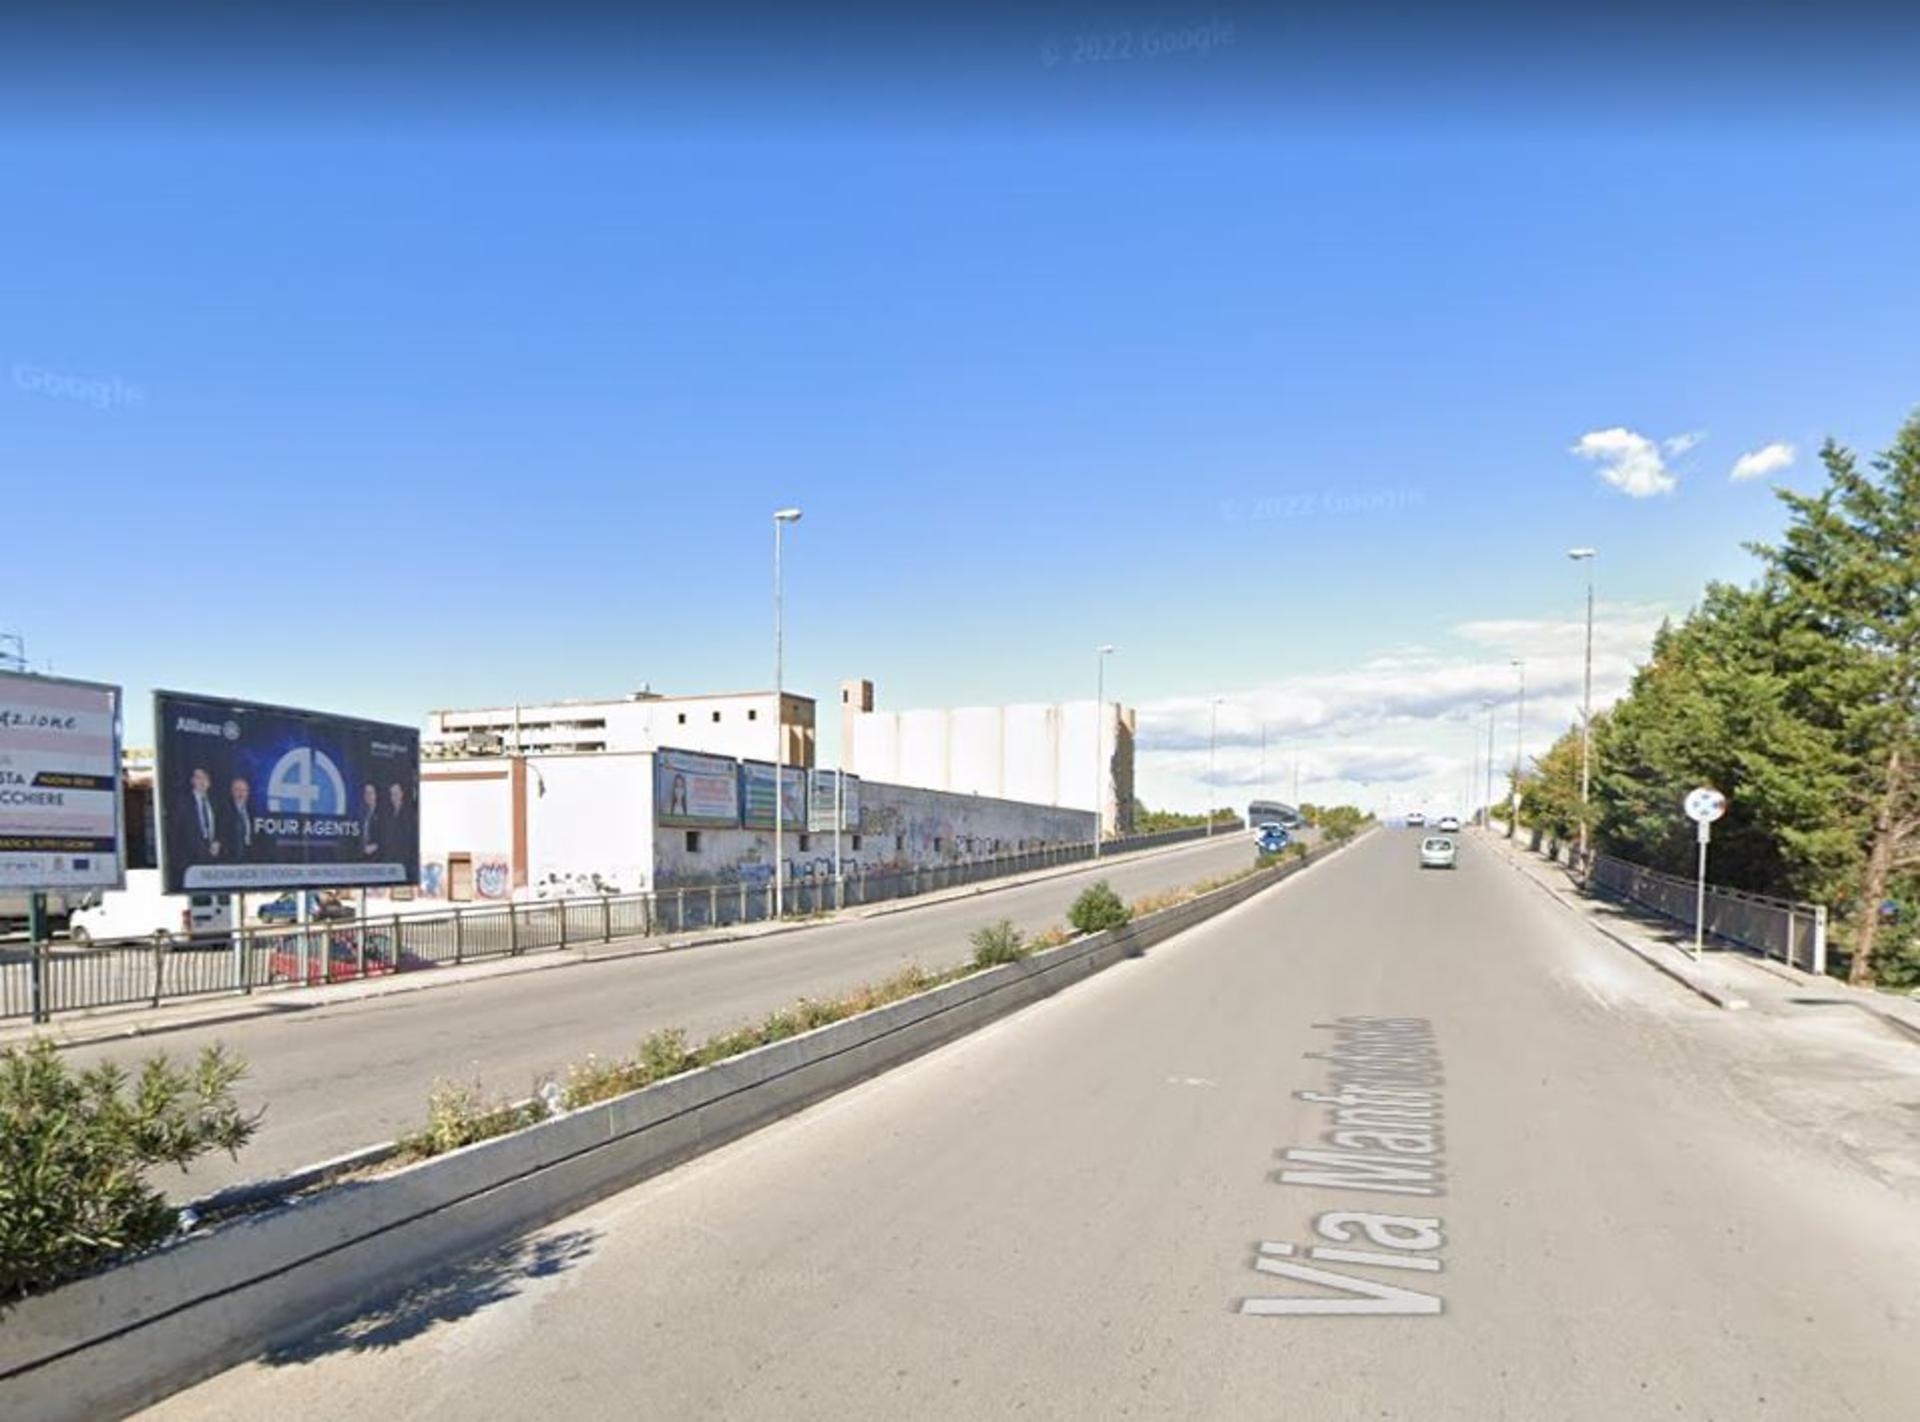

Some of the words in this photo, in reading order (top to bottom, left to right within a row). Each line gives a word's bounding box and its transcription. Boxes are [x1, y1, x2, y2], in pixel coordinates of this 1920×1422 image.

[176, 717, 222, 736] Allianz
[254, 817, 299, 835] FOUR
[303, 819, 360, 837] AGENTS
